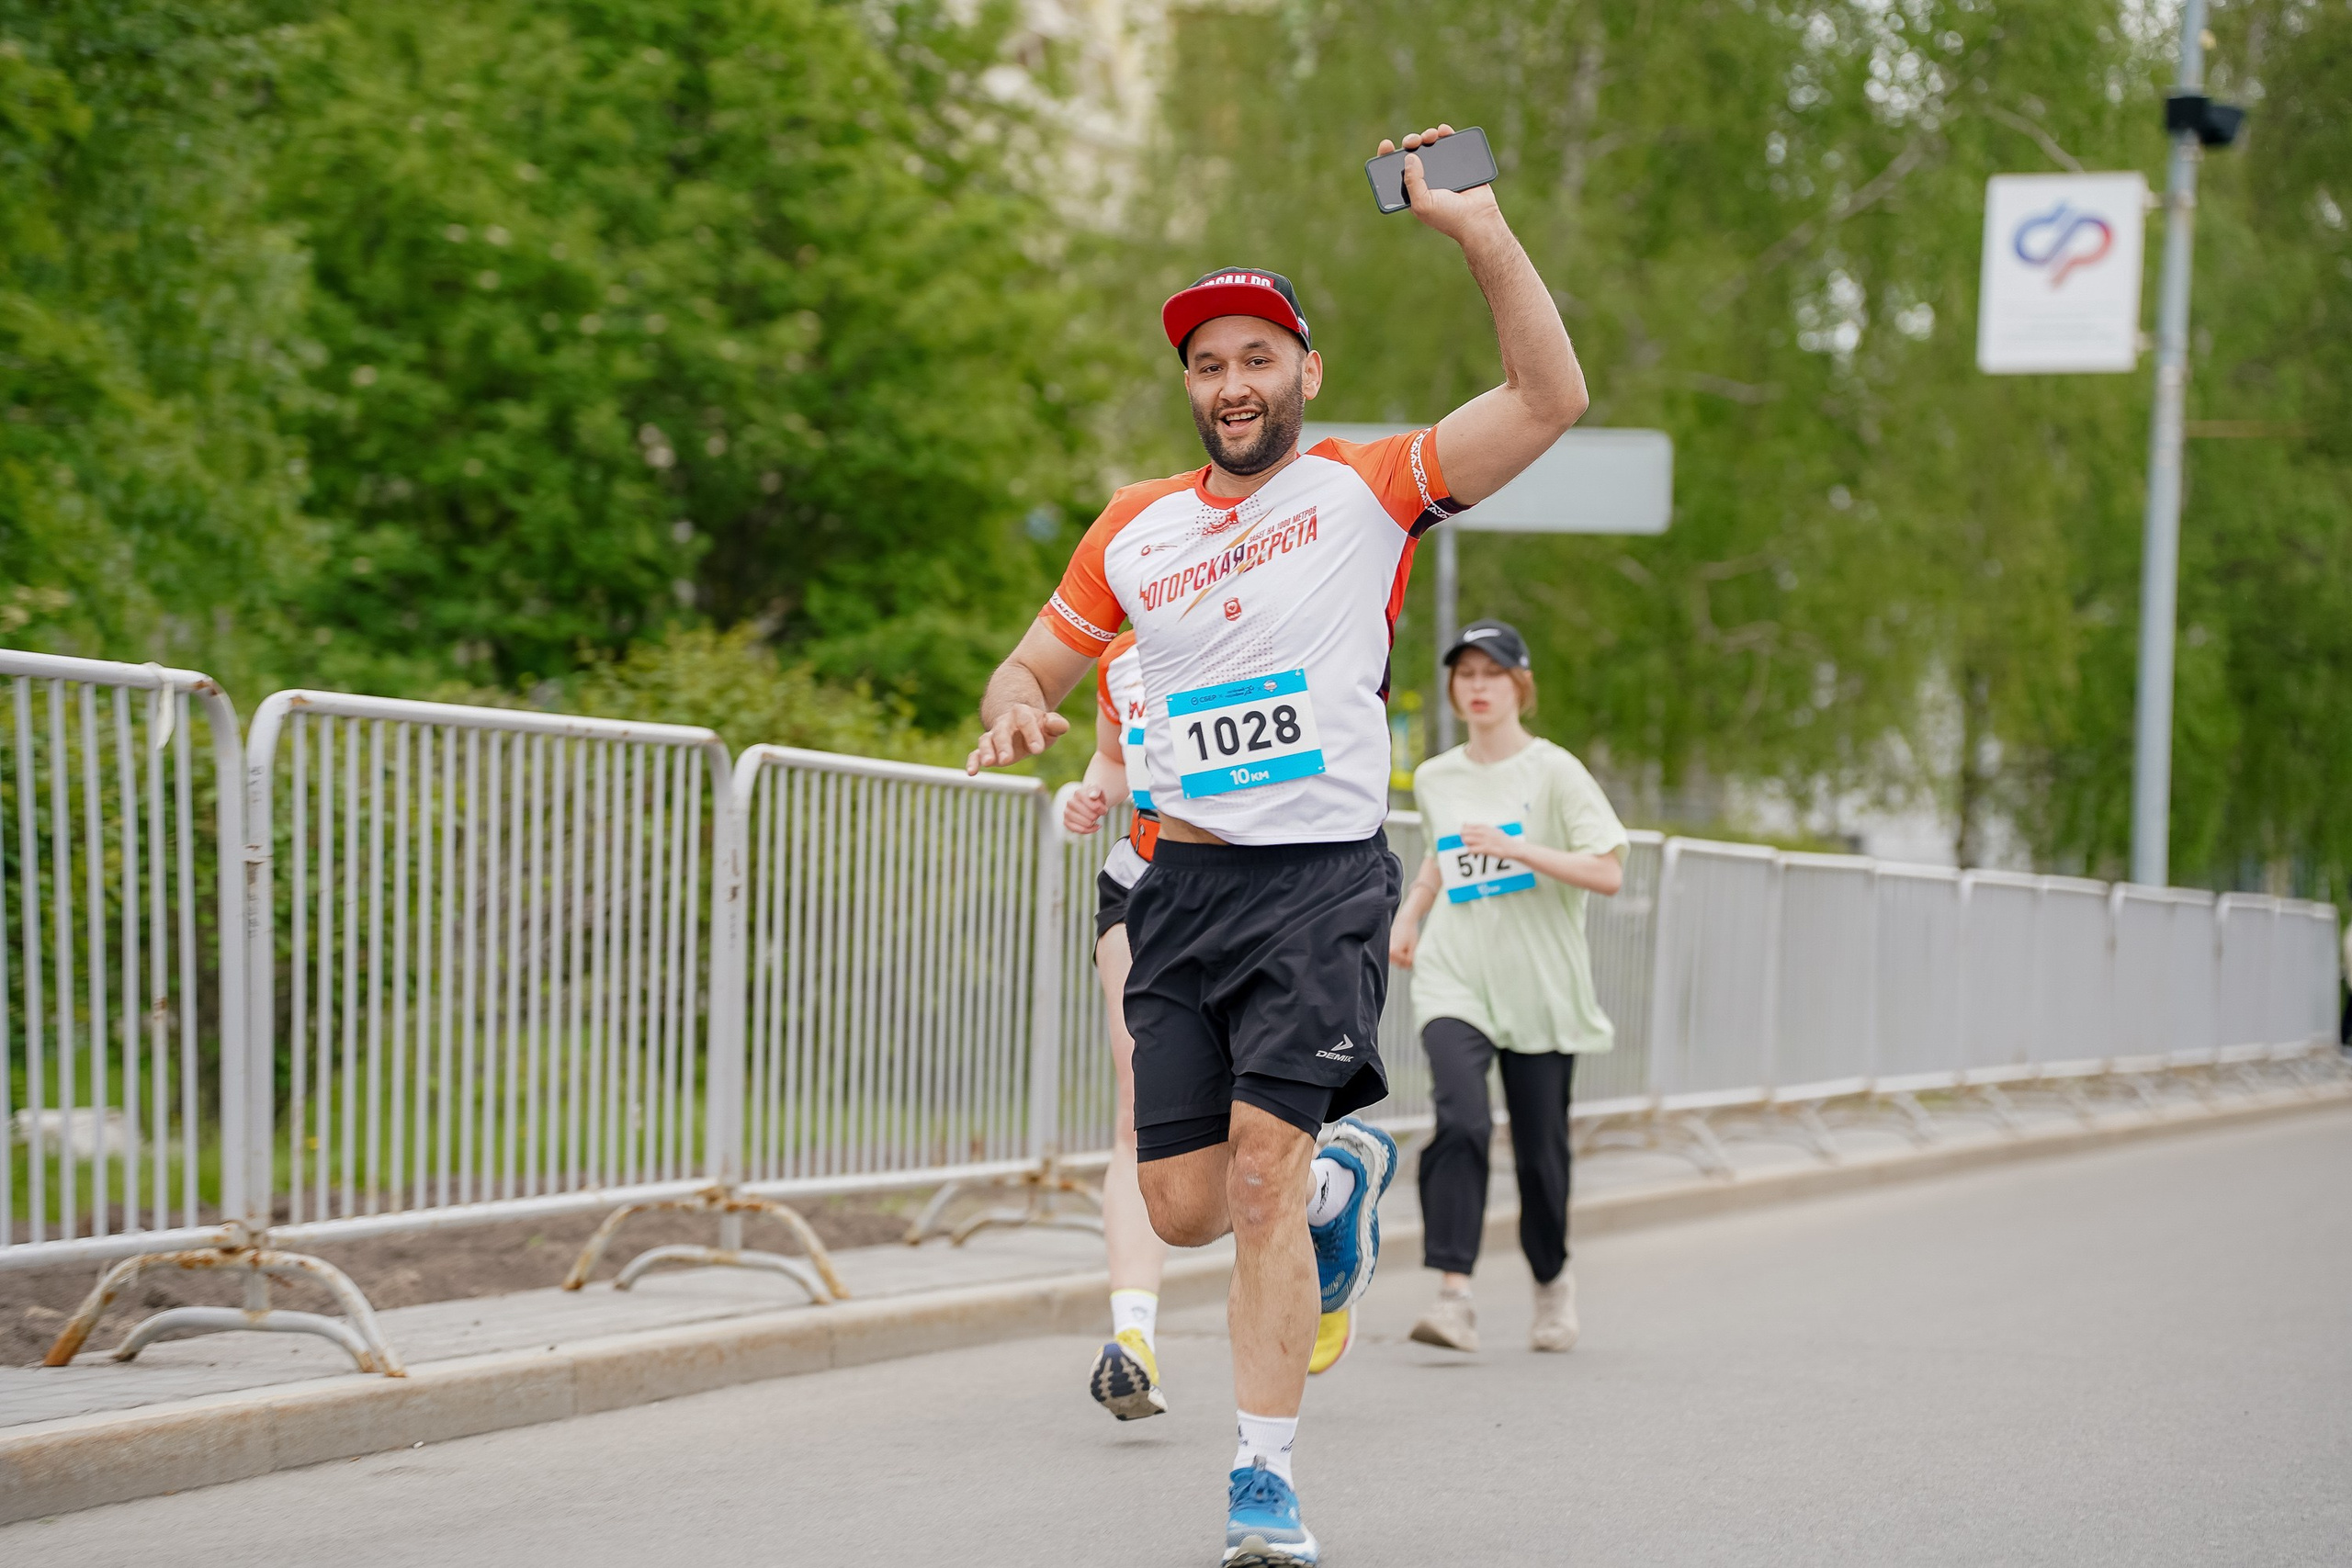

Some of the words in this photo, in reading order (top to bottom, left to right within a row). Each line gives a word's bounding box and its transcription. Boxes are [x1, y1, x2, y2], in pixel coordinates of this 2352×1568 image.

[1293, 505, 1317, 524] МЕТРОВ
[1243, 514, 1317, 573] ВЕРСТА
[1188, 705, 1301, 761] 1028
